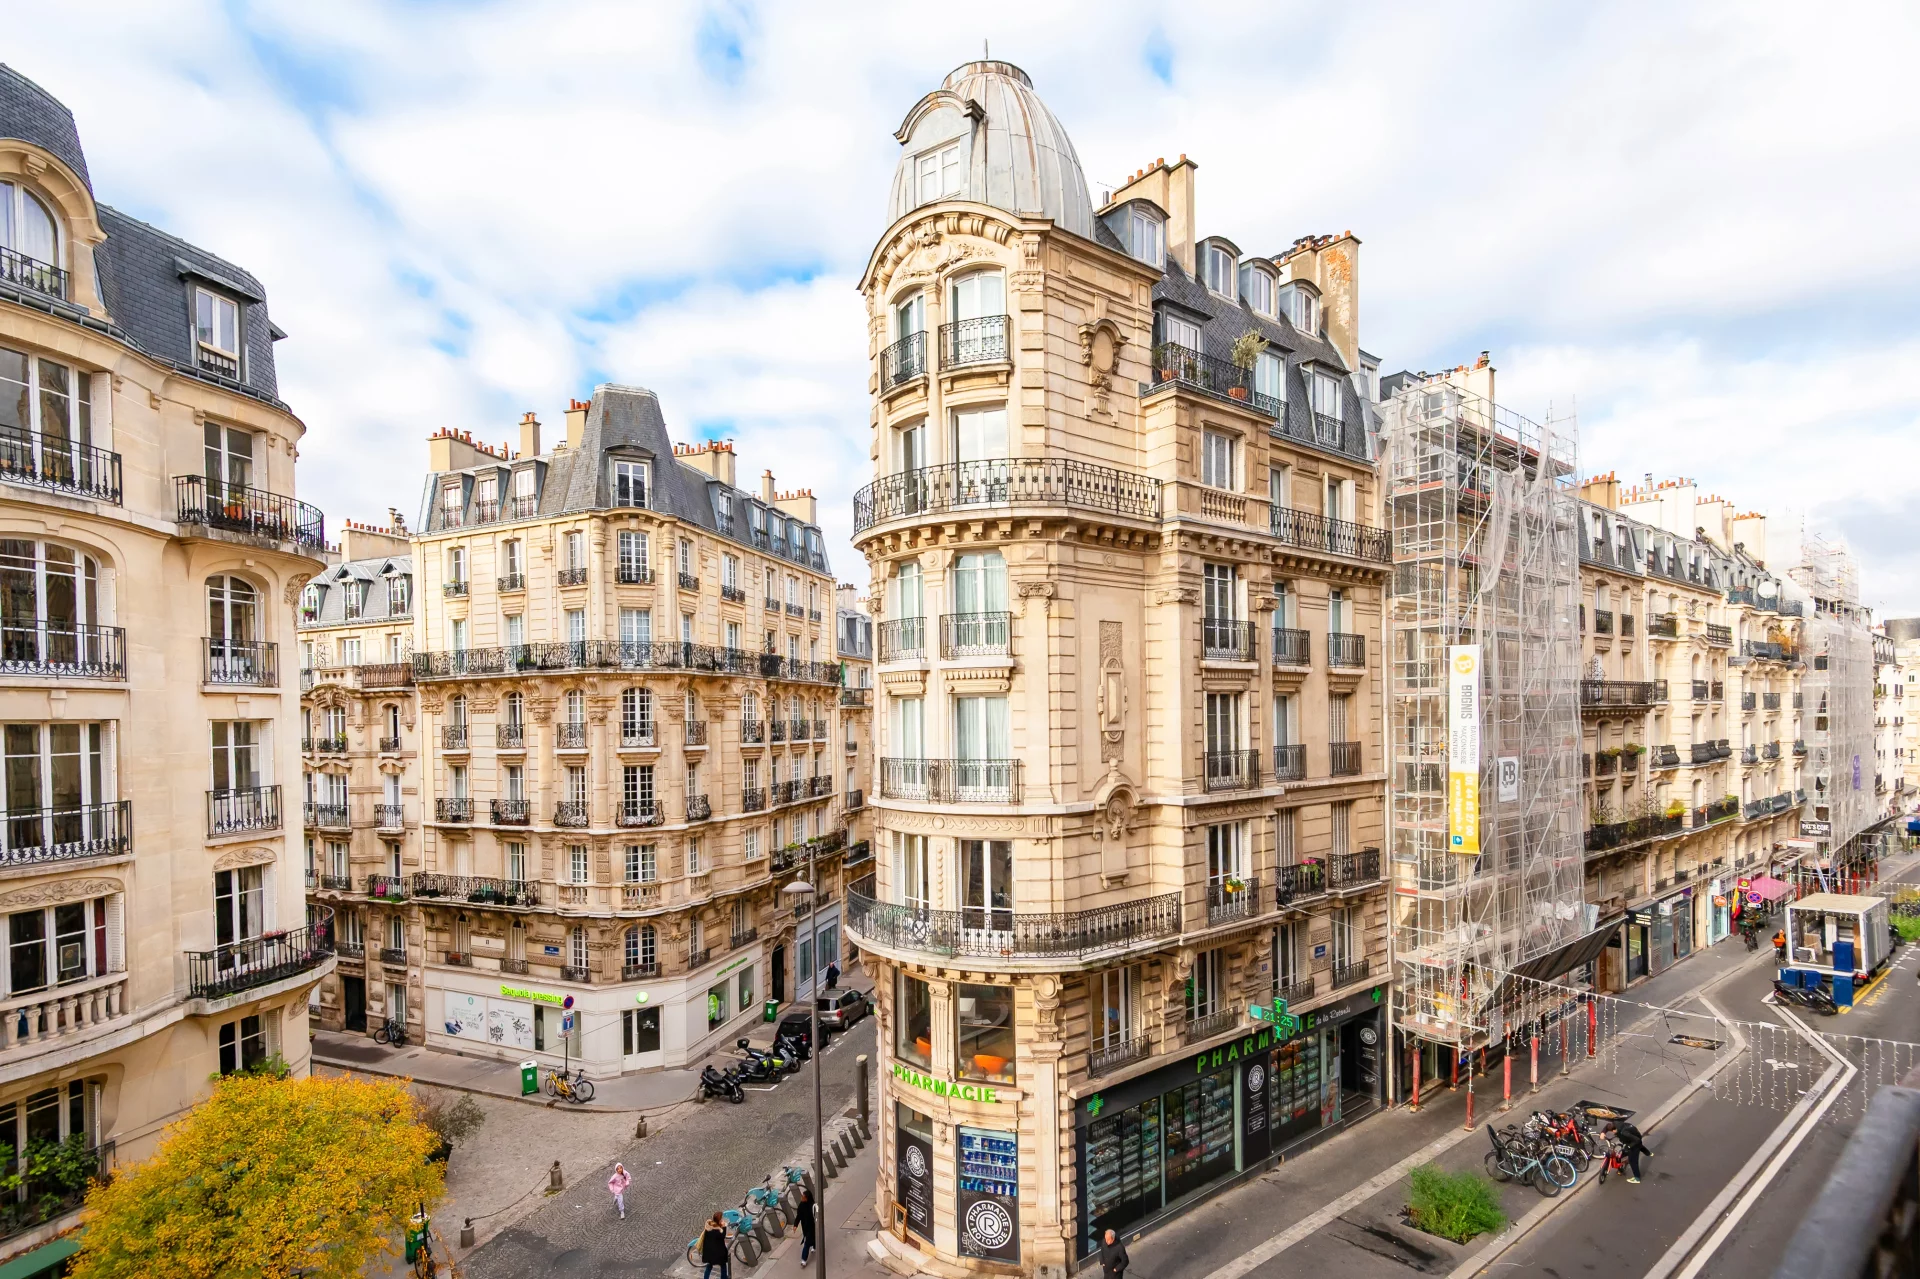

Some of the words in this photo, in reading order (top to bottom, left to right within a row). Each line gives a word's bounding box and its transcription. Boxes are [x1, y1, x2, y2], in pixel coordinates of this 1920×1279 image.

[1461, 684, 1473, 719] BAGNIS
[501, 984, 530, 998] Sequoia
[531, 991, 563, 1006] pressing
[1263, 1010, 1293, 1028] 21:25
[1196, 1013, 1315, 1074] PHARMIE
[893, 1063, 996, 1103] PHARMACIE
[969, 1203, 1009, 1227] PHARMACIE
[984, 1217, 997, 1234] R
[970, 1227, 1008, 1246] ROTONDE
